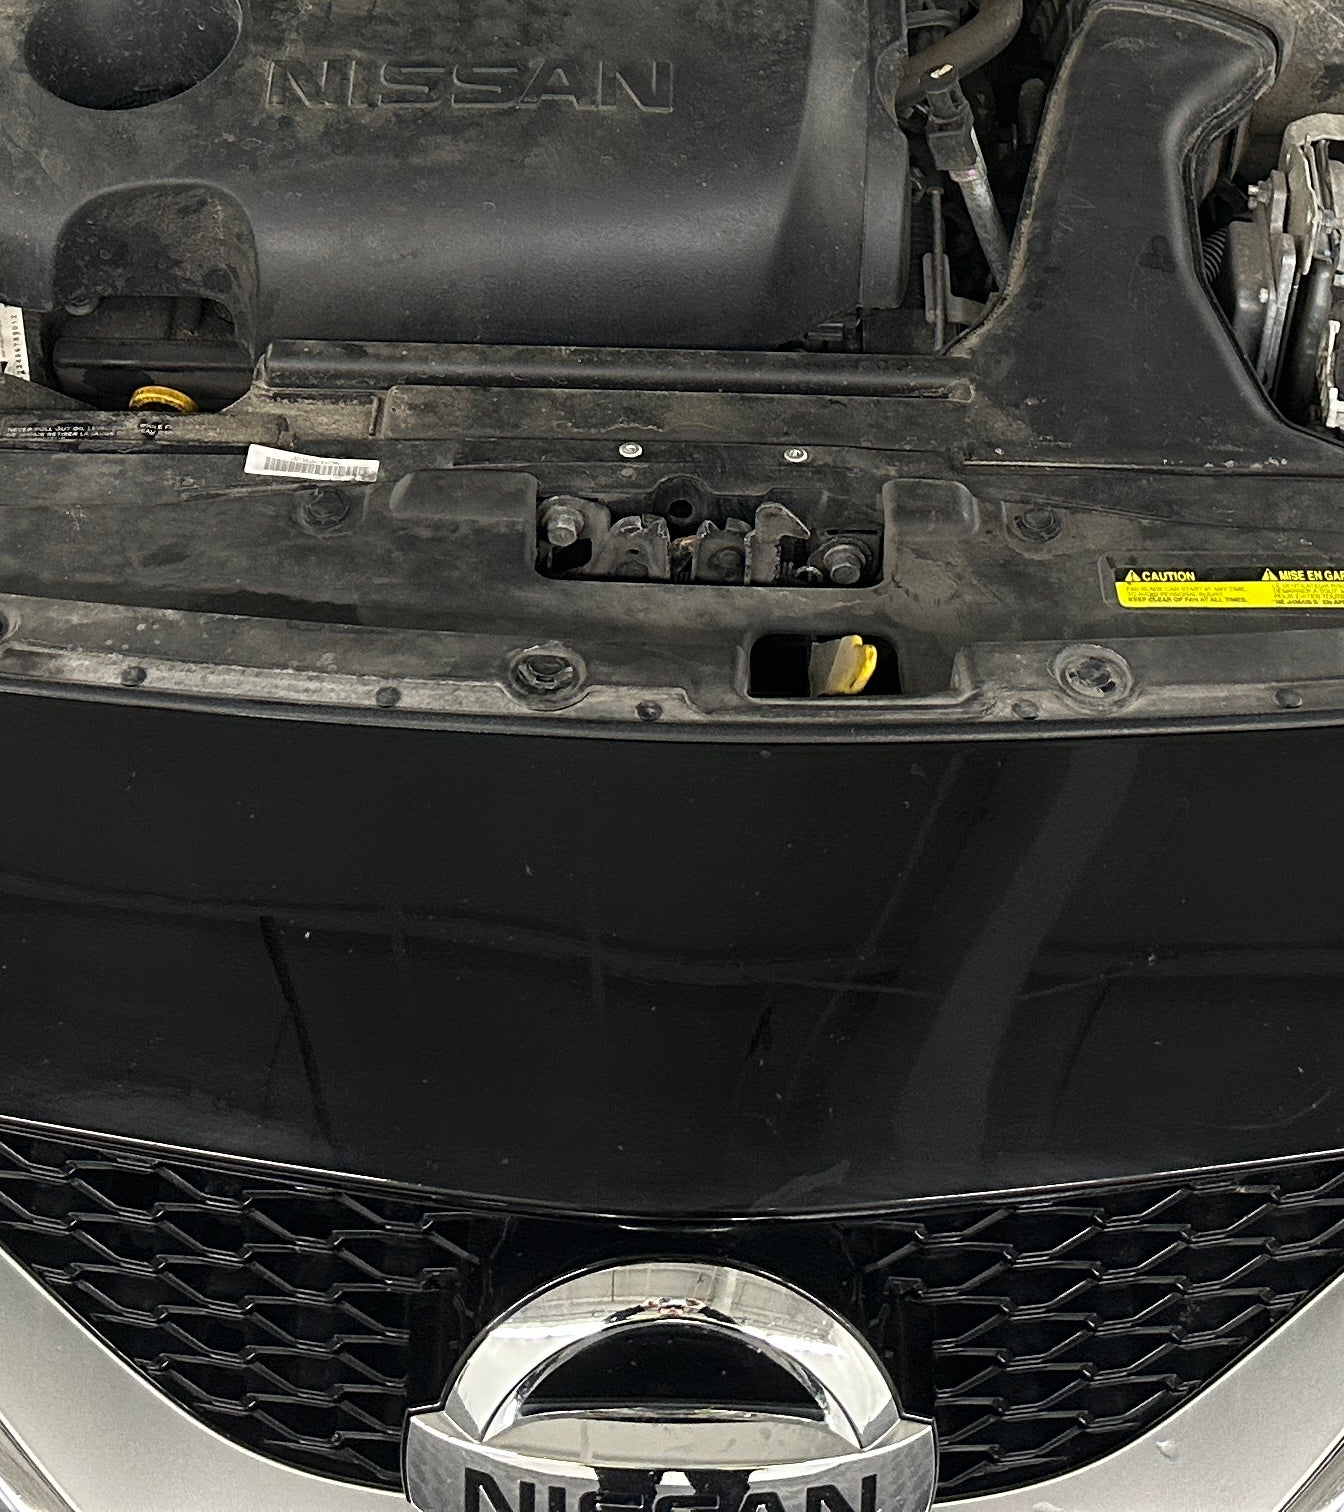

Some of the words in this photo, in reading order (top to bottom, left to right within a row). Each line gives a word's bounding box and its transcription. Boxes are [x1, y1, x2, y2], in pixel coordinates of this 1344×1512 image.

[264, 59, 675, 114] NISSAN
[1141, 570, 1196, 582] CAUTION
[1278, 570, 1305, 581] MISE
[1306, 569, 1323, 581] EN
